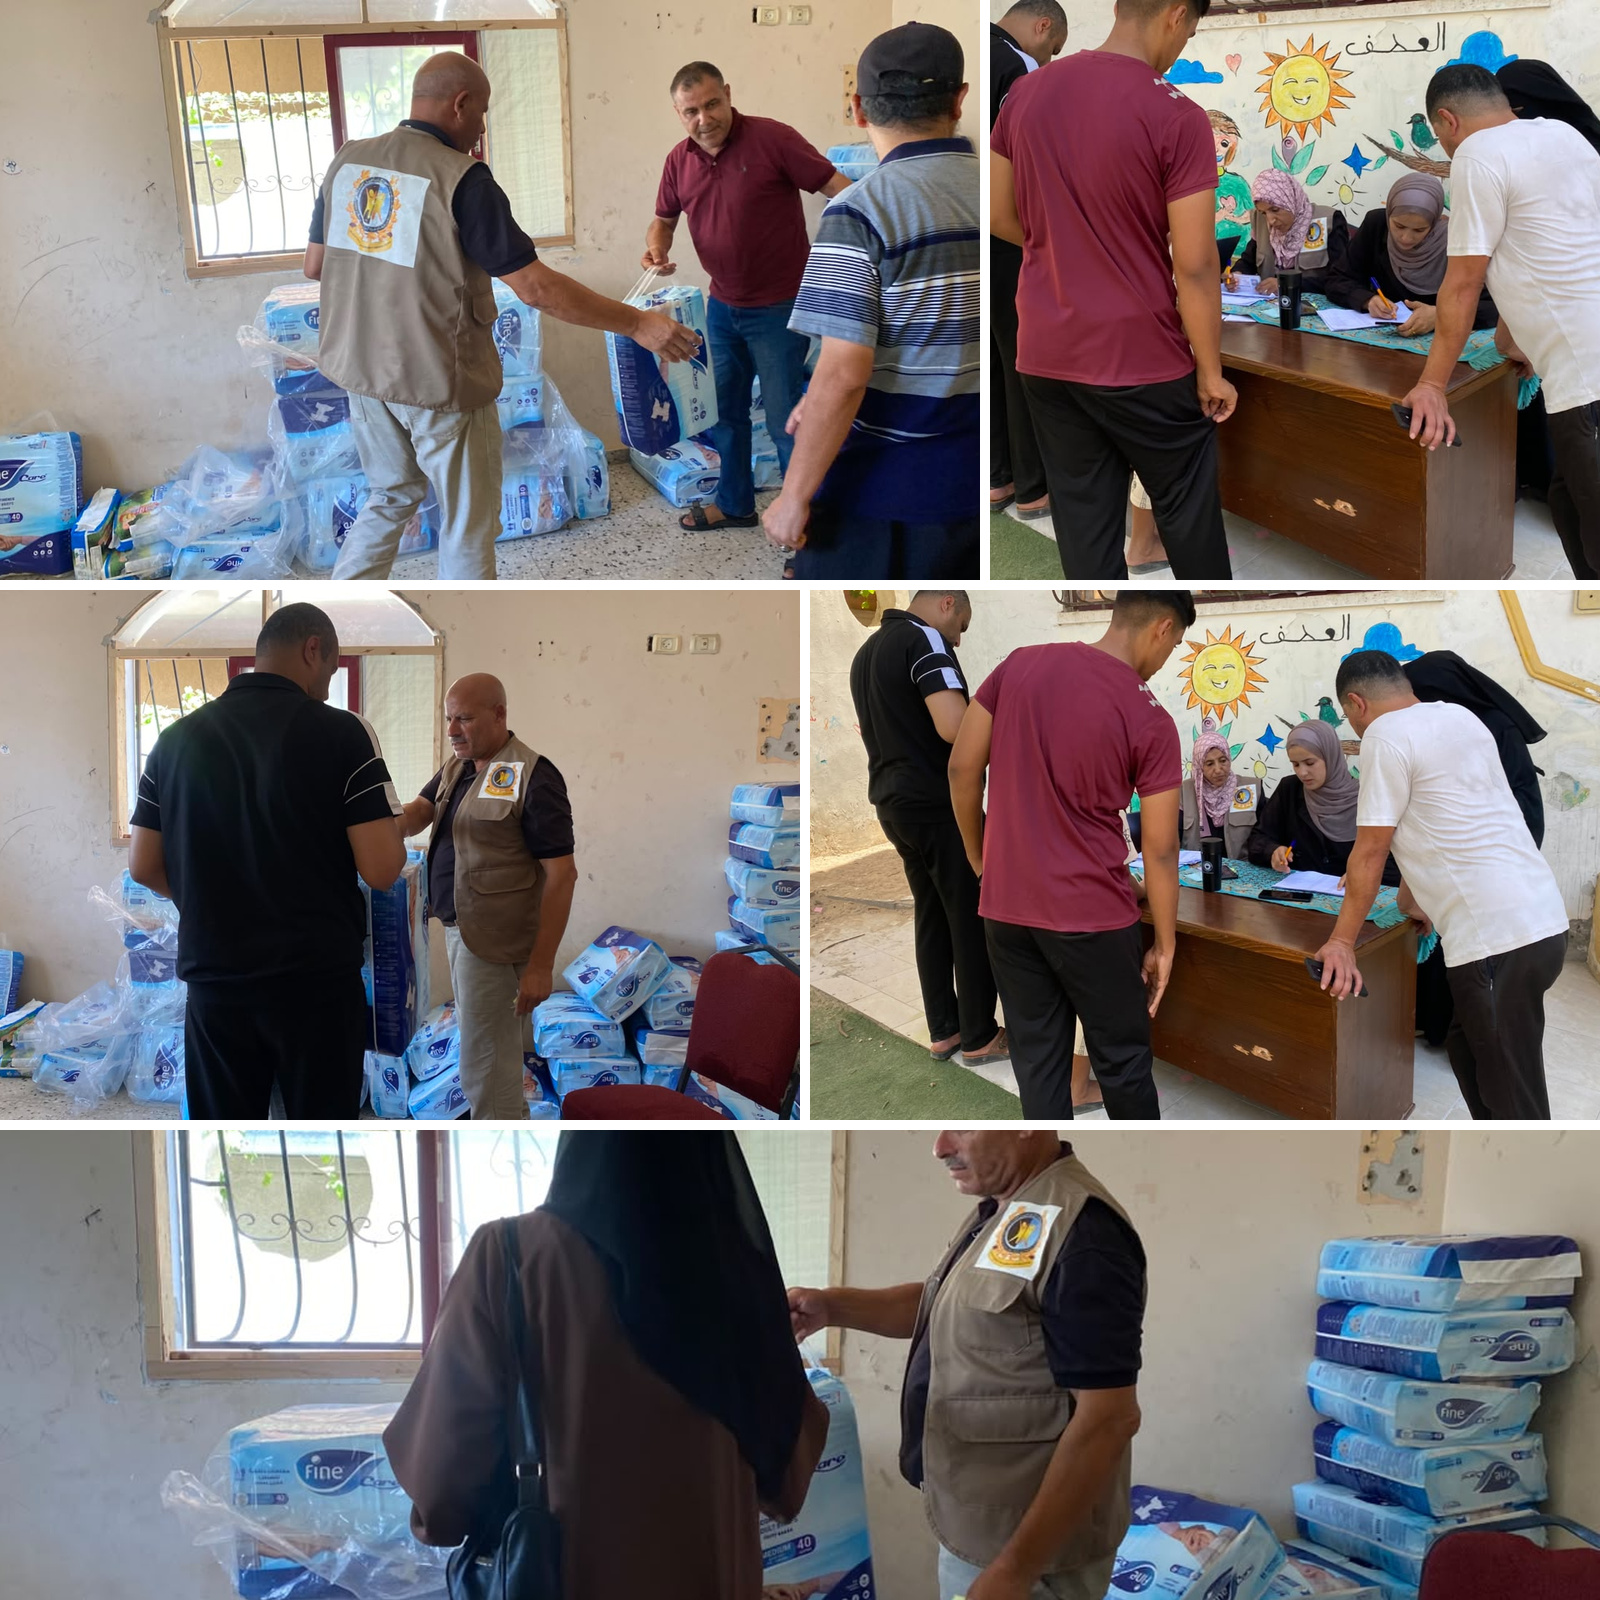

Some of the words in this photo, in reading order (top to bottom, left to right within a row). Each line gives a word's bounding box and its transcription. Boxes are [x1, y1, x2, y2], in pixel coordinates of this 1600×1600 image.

[305, 1455, 344, 1480] fine
[815, 1454, 847, 1472] are
[797, 1536, 812, 1549] 40
